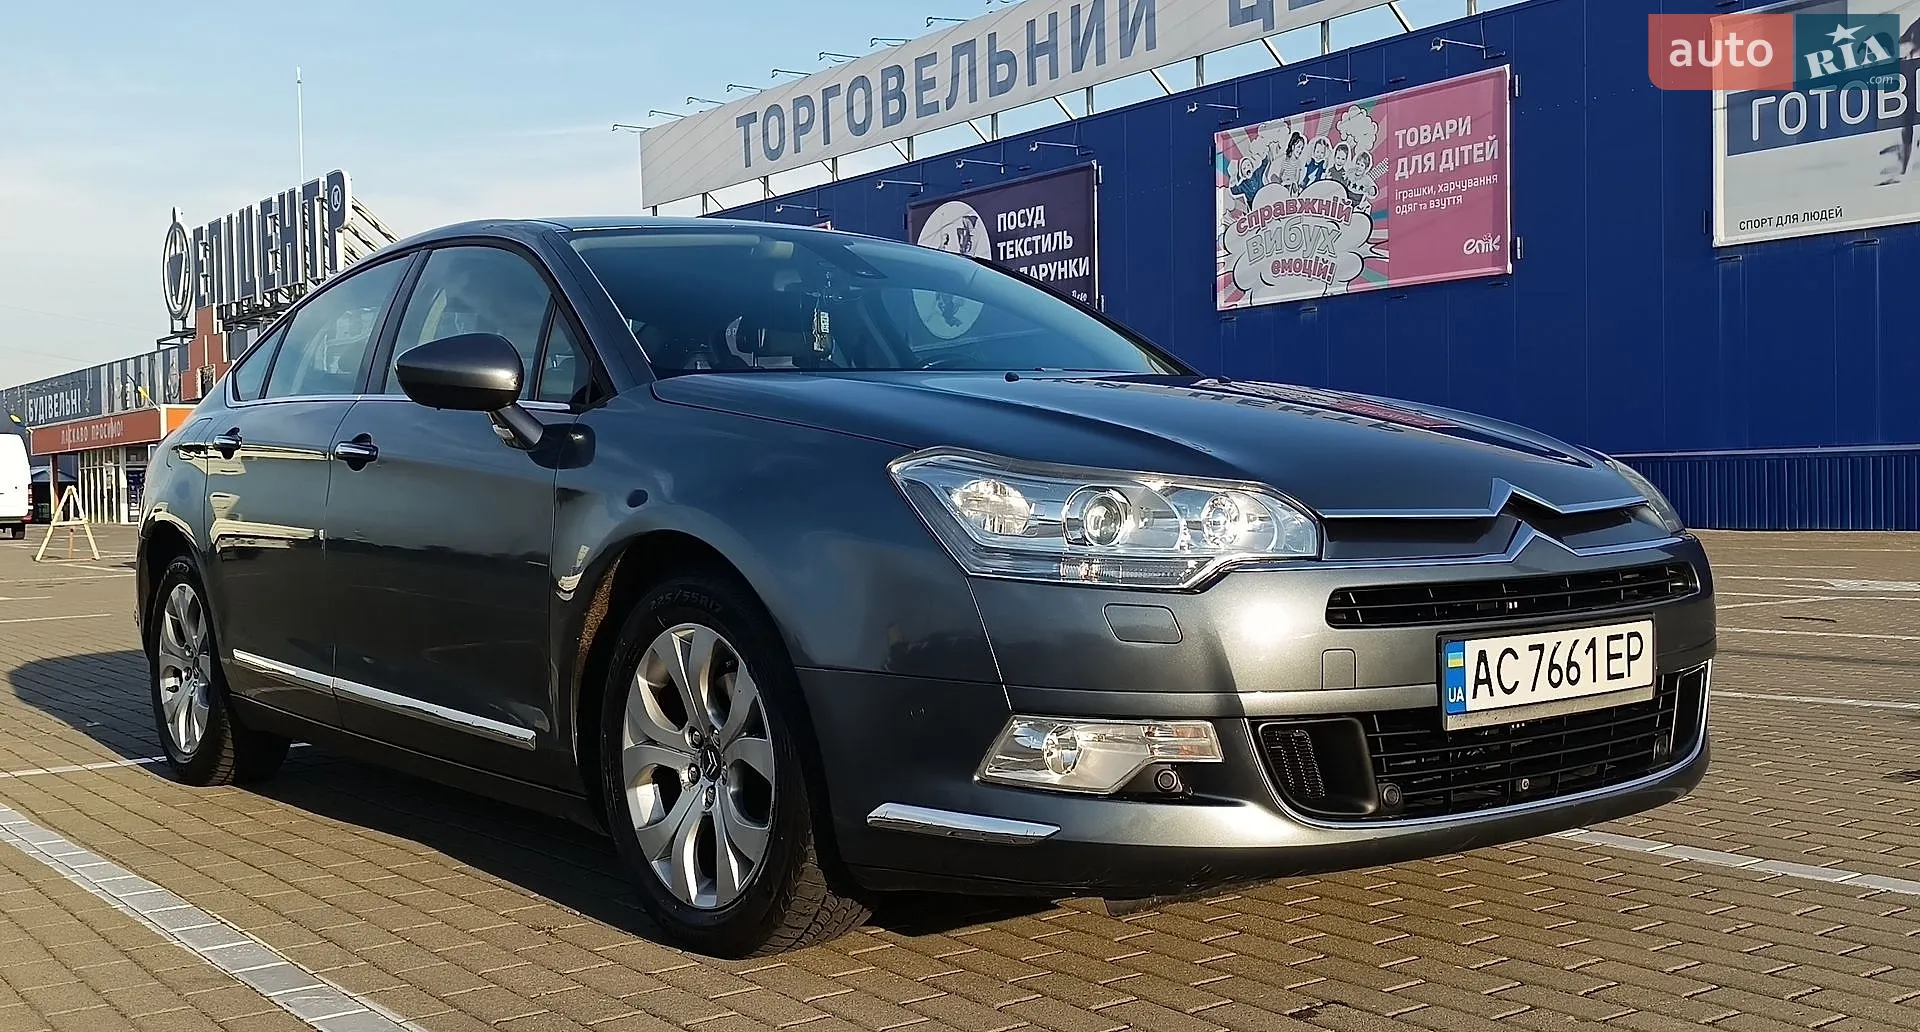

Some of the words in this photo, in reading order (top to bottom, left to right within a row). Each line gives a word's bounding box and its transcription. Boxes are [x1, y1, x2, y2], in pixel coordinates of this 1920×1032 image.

[1752, 67, 1920, 141] ГОТОВ
[1395, 115, 1472, 149] ТОВАРИ
[1395, 152, 1436, 181] ДЛЯ
[1440, 134, 1499, 173] ДІТЕЙ
[1395, 186, 1436, 202] іграшки,
[1438, 174, 1498, 194] харчування
[1395, 202, 1418, 215] одяг
[1419, 203, 1428, 211] та
[1429, 195, 1463, 209] взуття
[997, 205, 1046, 233] ПОСУД
[1236, 196, 1353, 235] справжній
[1739, 216, 1774, 231] СПОРТ
[1775, 213, 1799, 228] ДЛЯ
[1801, 206, 1843, 223] ЛЮДЕЙ
[193, 168, 348, 307] ЕПІЦЕНТР
[997, 230, 1074, 261] ТЕКСТИЛЬ
[1246, 216, 1340, 263] вибух
[1271, 256, 1336, 283] емоцій!
[28, 388, 82, 424] БУДІВЕЛЬНІ
[1472, 647, 1519, 701] AC
[1528, 637, 1598, 692] 7661
[1606, 631, 1644, 681] EP
[1448, 686, 1465, 703] UA
